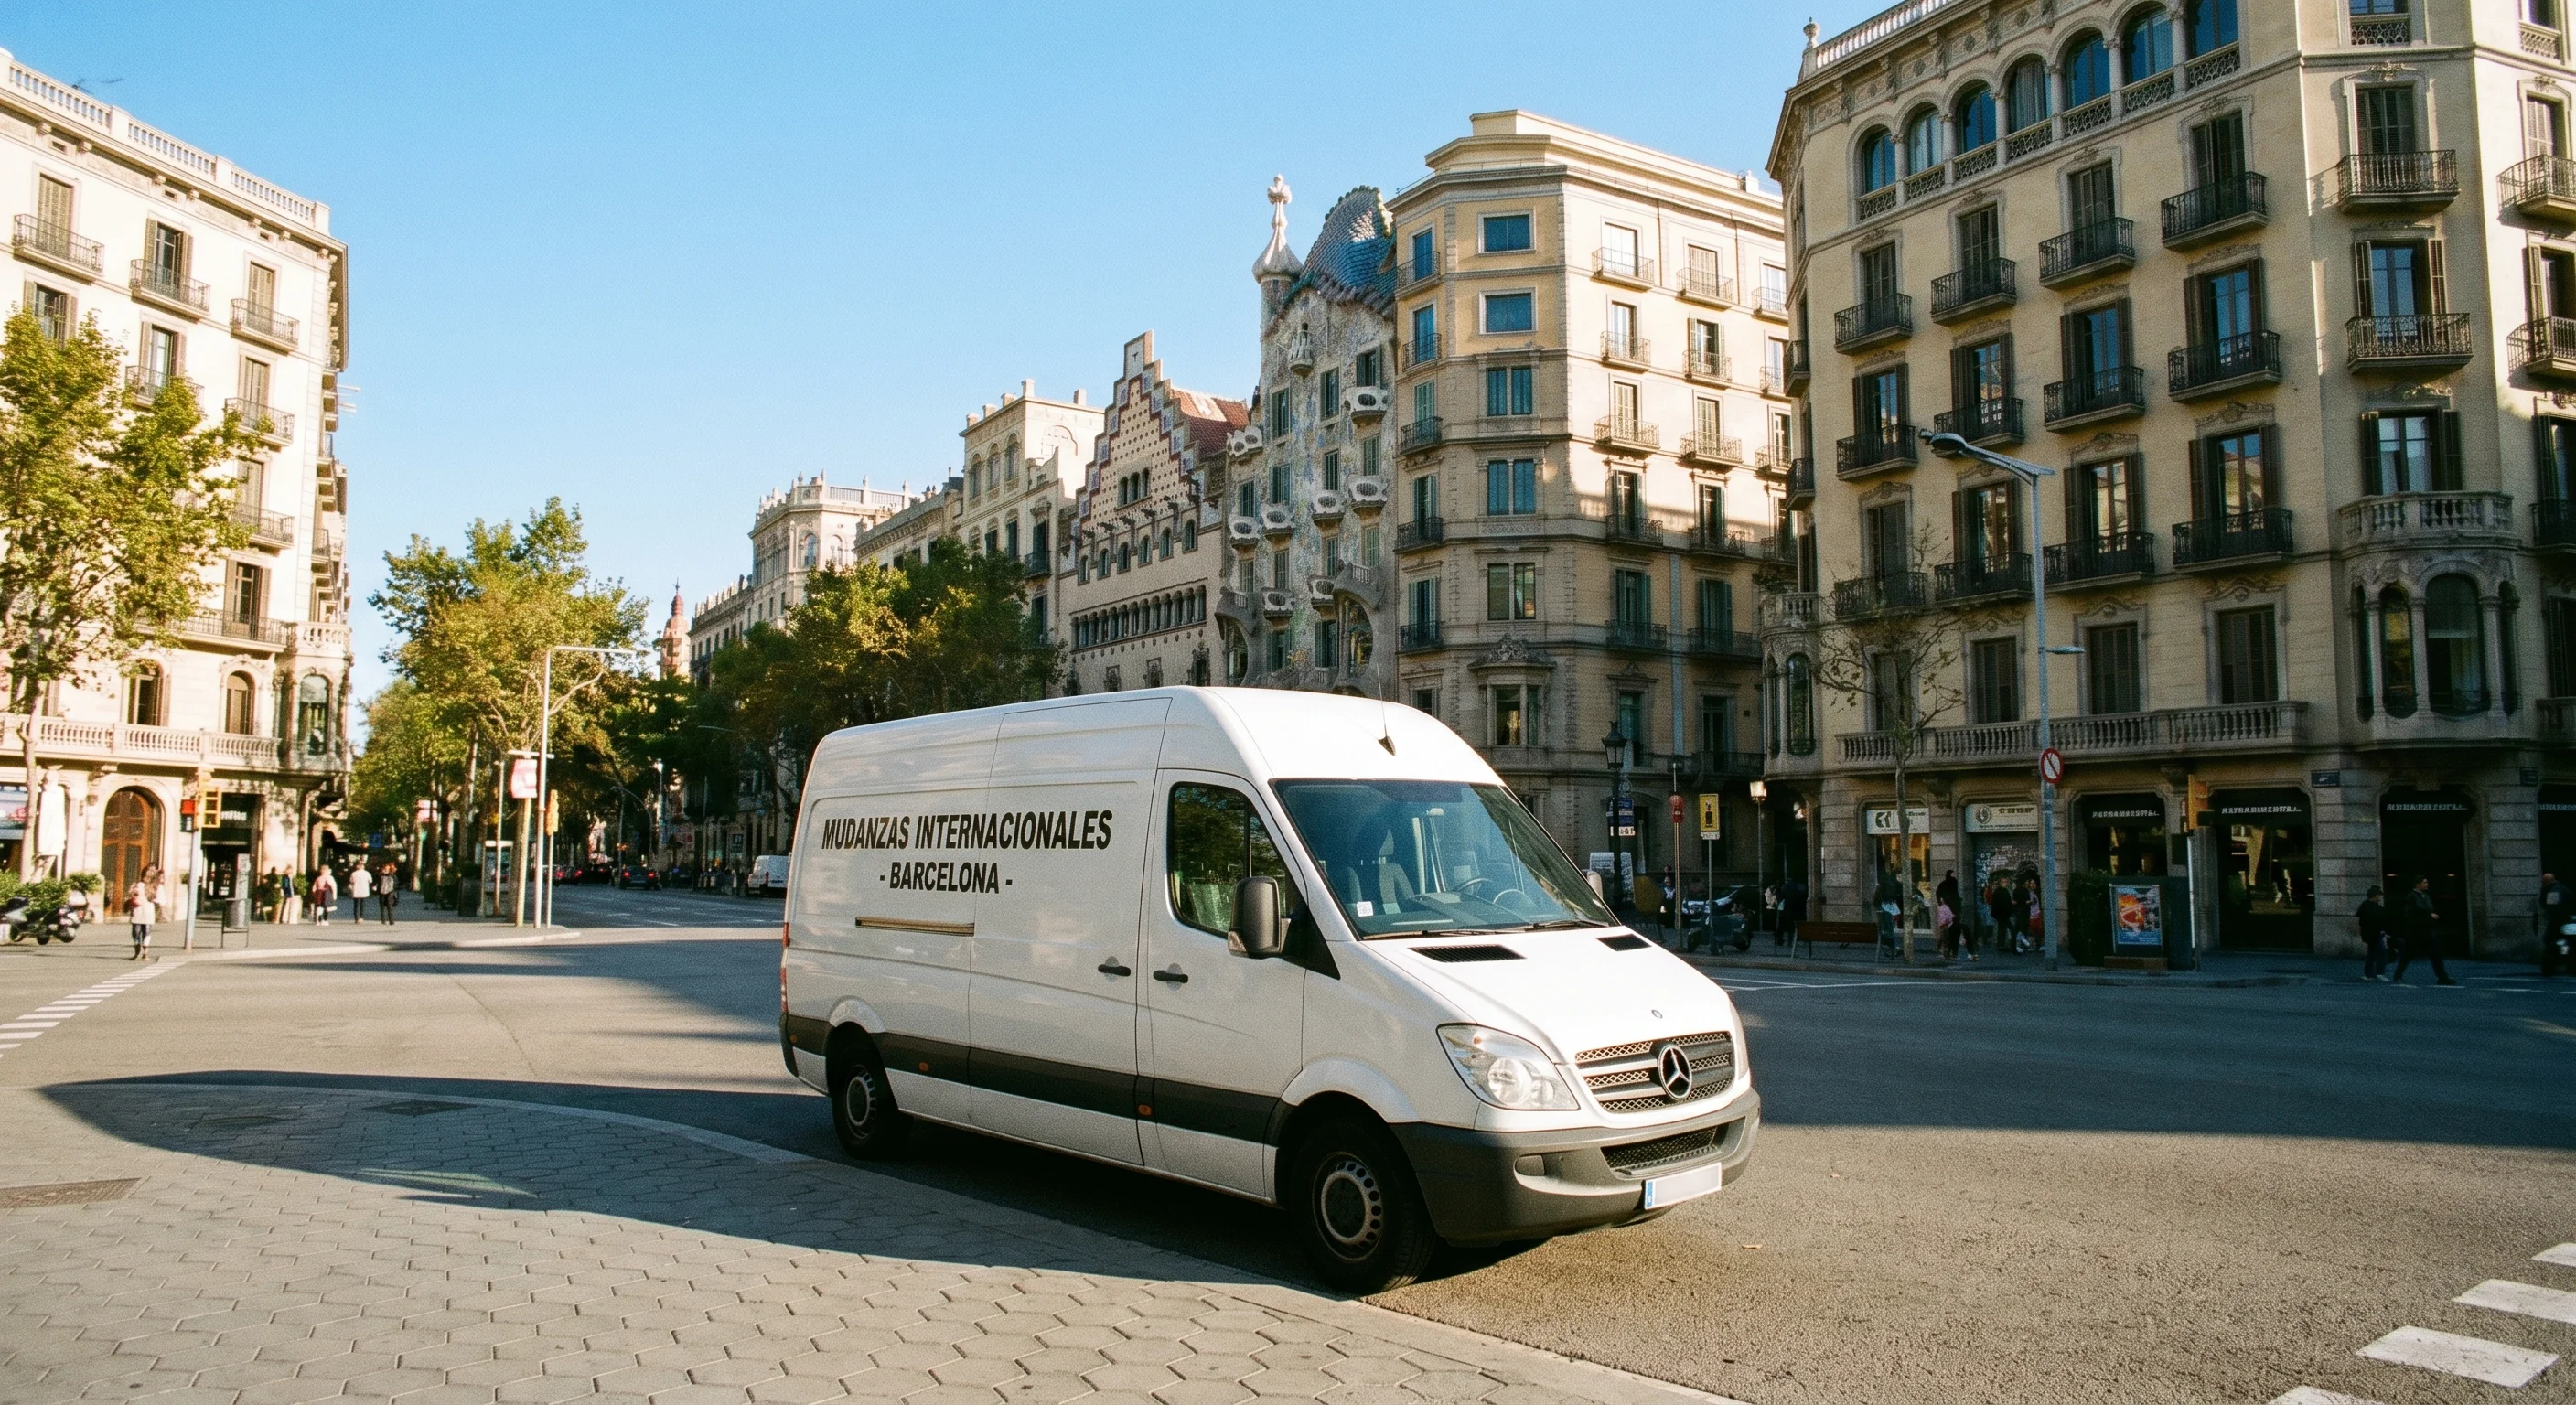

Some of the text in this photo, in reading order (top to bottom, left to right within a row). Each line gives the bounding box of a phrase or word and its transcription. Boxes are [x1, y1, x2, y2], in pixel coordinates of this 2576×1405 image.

[821, 810, 1113, 849] MUDANZAS INTERNACIONALES
[889, 861, 1000, 894] BARCELONA
